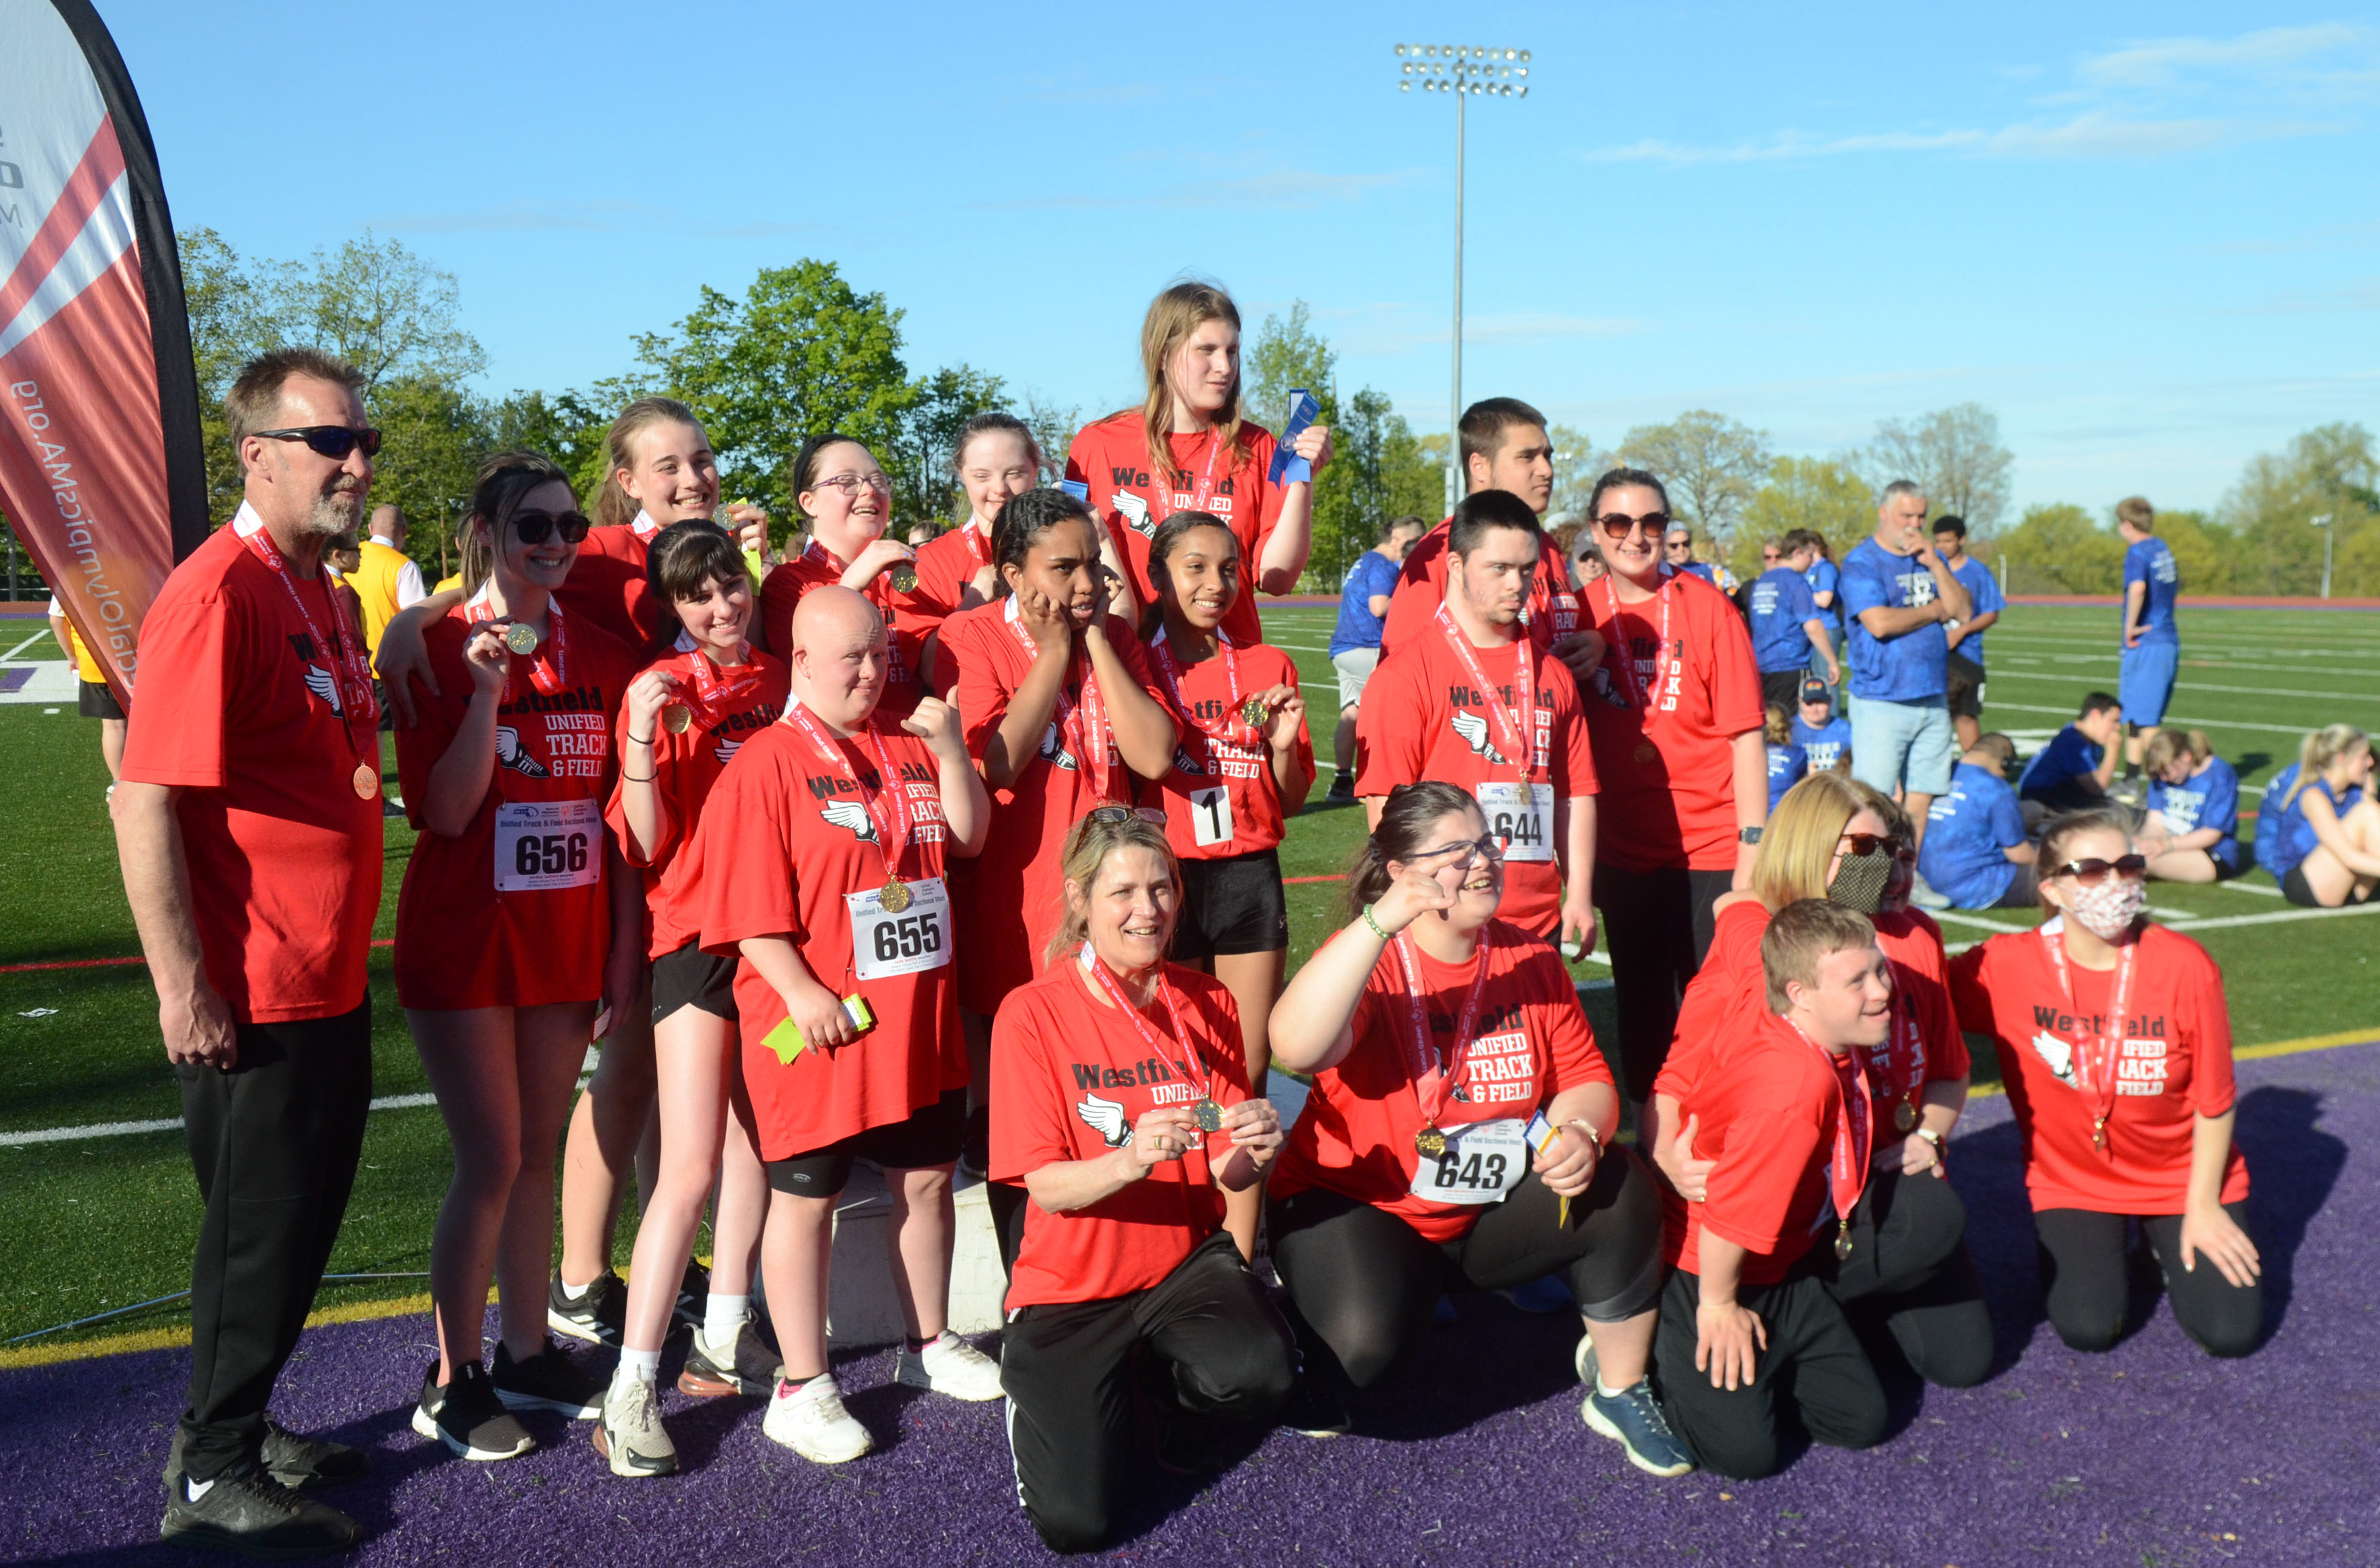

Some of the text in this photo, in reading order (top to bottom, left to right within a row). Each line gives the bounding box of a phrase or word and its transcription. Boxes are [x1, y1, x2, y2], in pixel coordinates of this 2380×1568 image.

[280, 570, 309, 619] UNIFIED SPORTS
[545, 714, 605, 732] UNIFIED
[545, 733, 607, 757] TRACK
[553, 758, 602, 777] & FIELD
[1207, 760, 1260, 779] & FIELD
[906, 783, 939, 799] IFIED
[895, 791, 903, 815] UNIFIED
[910, 800, 947, 823] RACK
[1201, 791, 1221, 840] 1
[914, 824, 946, 845] FIELD
[1495, 813, 1542, 846] 644
[516, 832, 588, 876] 656
[856, 908, 876, 917] Unified
[874, 912, 941, 961] 655
[1398, 936, 1415, 982] UNIFIED SPORTS
[2122, 1039, 2167, 1057] IFIED
[1466, 1054, 1534, 1082] TRACK
[2118, 1058, 2169, 1080] ACK
[1151, 1080, 1209, 1105] UNIFI
[1472, 1081, 1532, 1103] & FIELD
[2116, 1080, 2164, 1097] FIELD
[1435, 1151, 1506, 1189] 643
